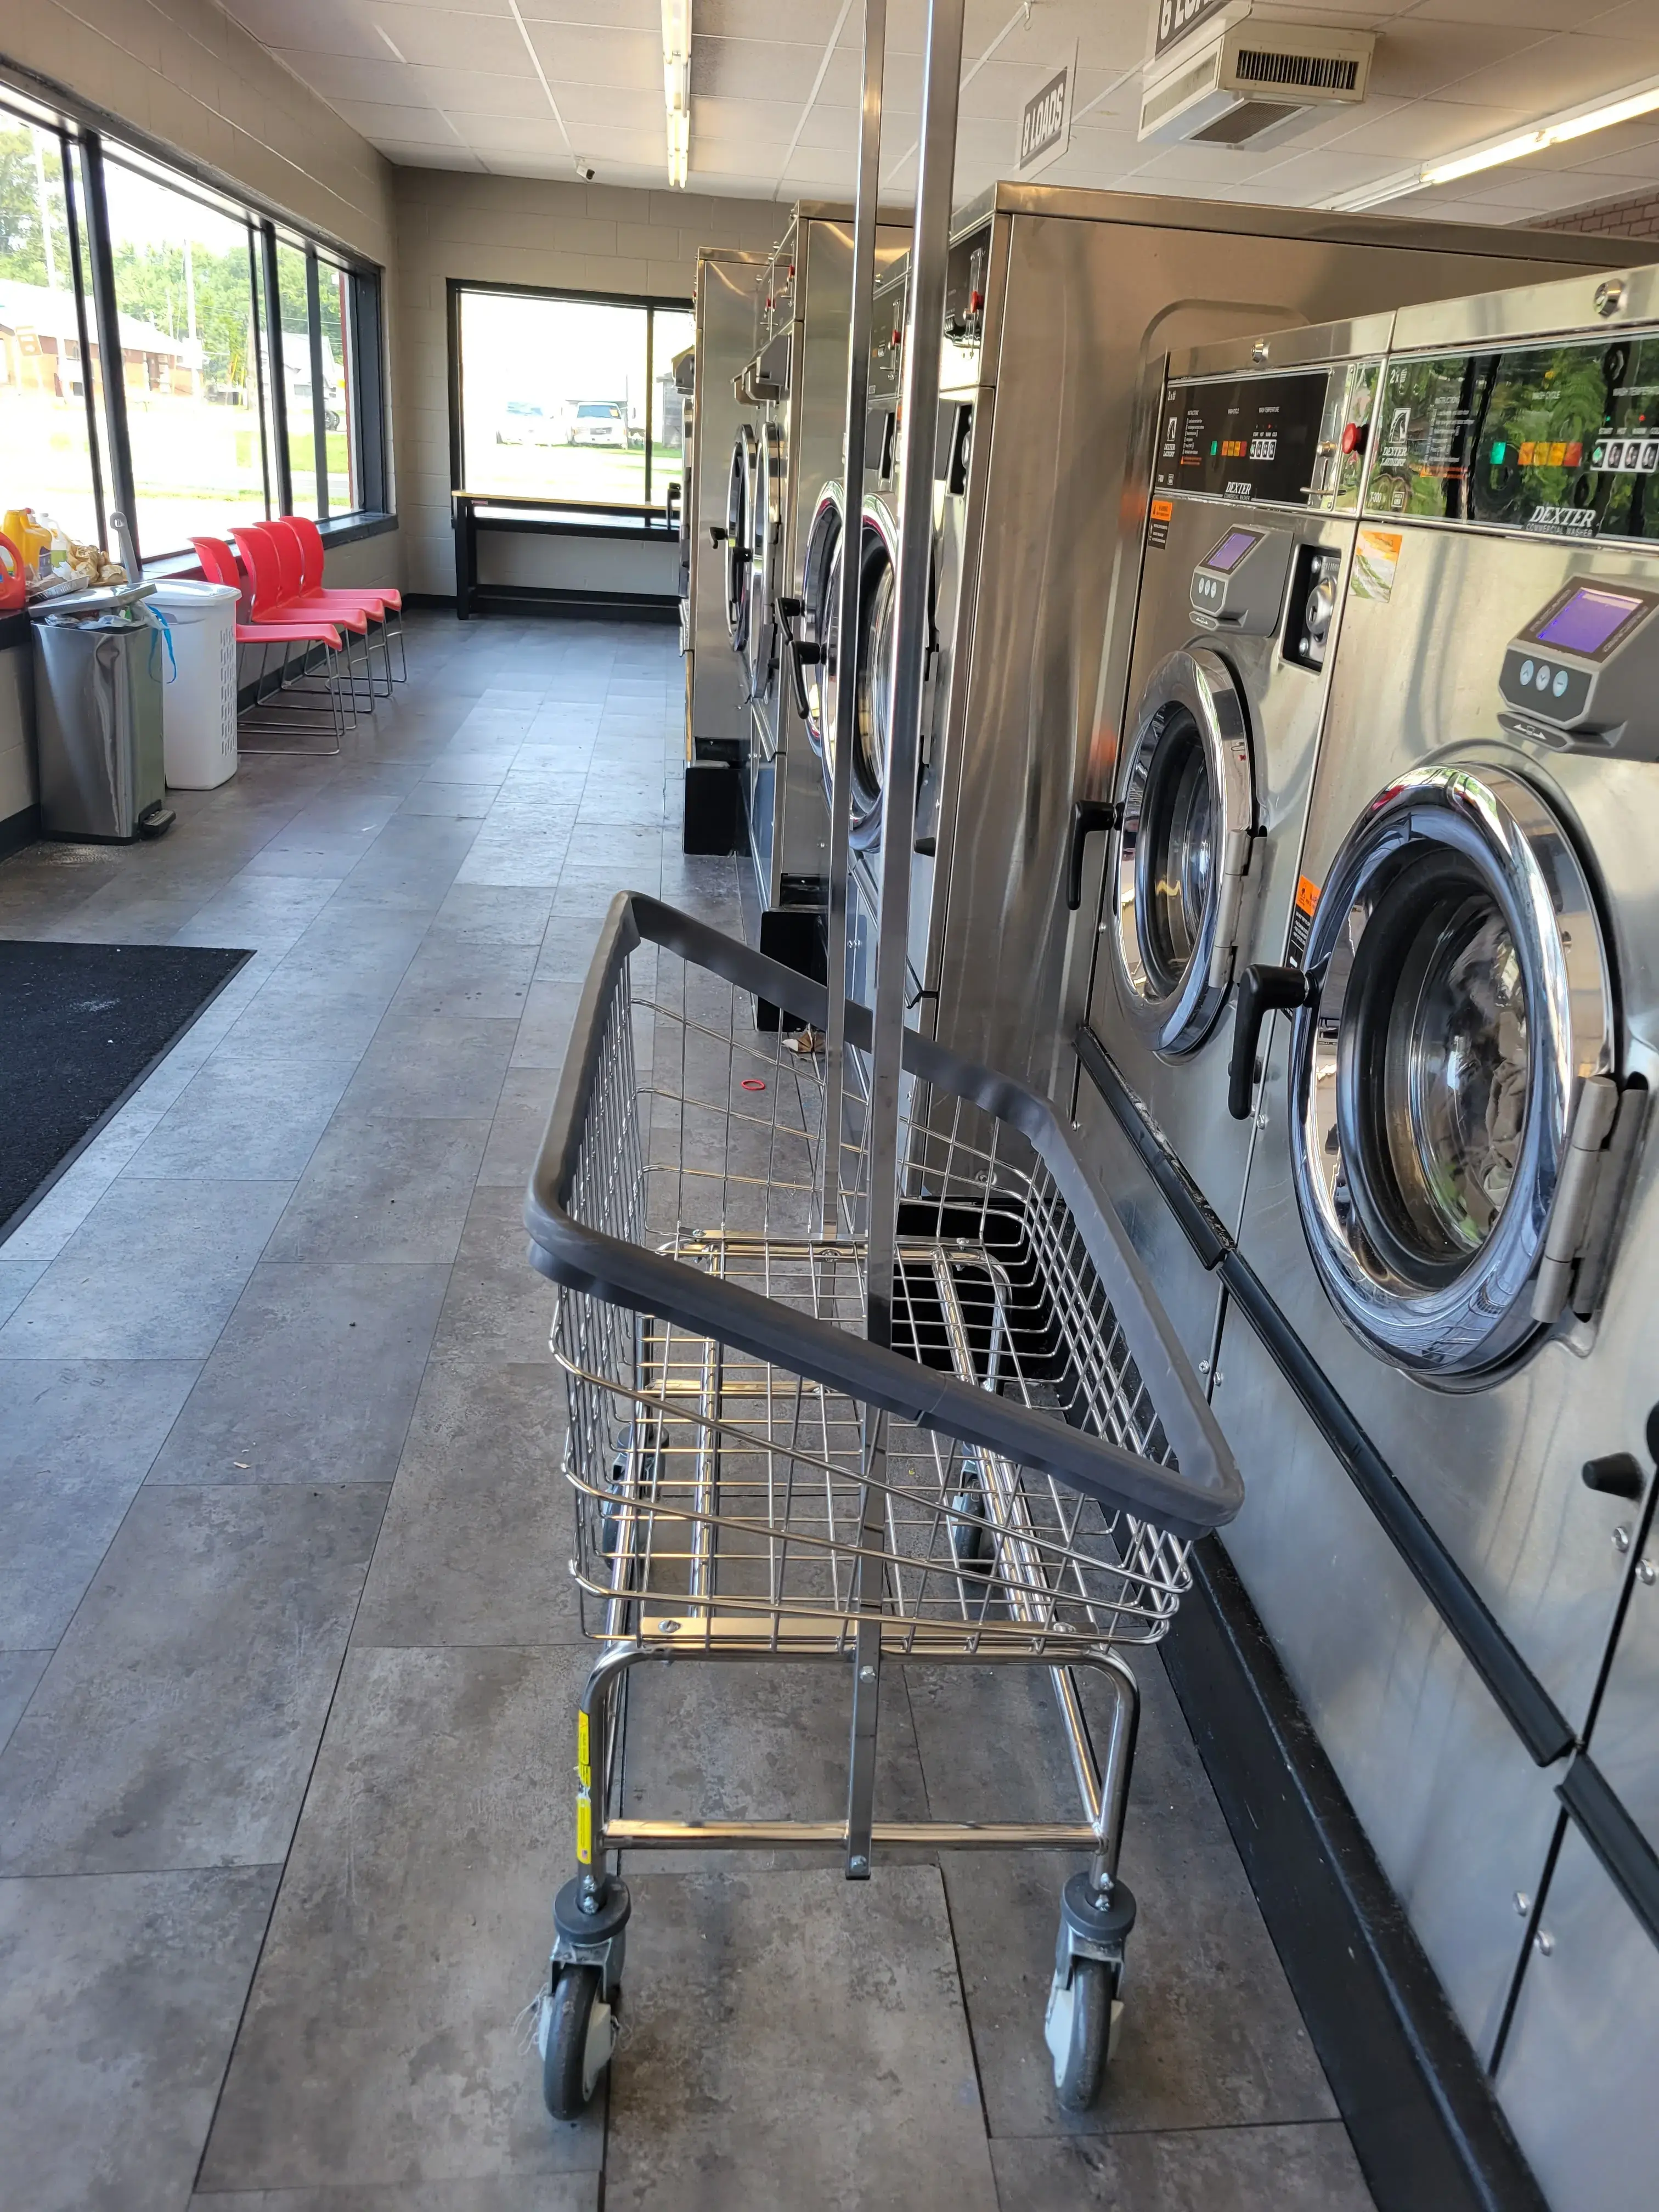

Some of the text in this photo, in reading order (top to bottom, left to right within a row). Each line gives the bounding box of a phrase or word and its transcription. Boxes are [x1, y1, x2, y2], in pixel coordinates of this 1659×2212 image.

[1161, 0, 1172, 40] 6
[1022, 82, 1064, 157] 8 LOADS
[1382, 447, 1407, 456] DEXTER
[1225, 481, 1251, 495] DEXTER
[1528, 505, 1596, 528] DEXTER
[1526, 523, 1593, 538] COMMERCIAL WASHER
